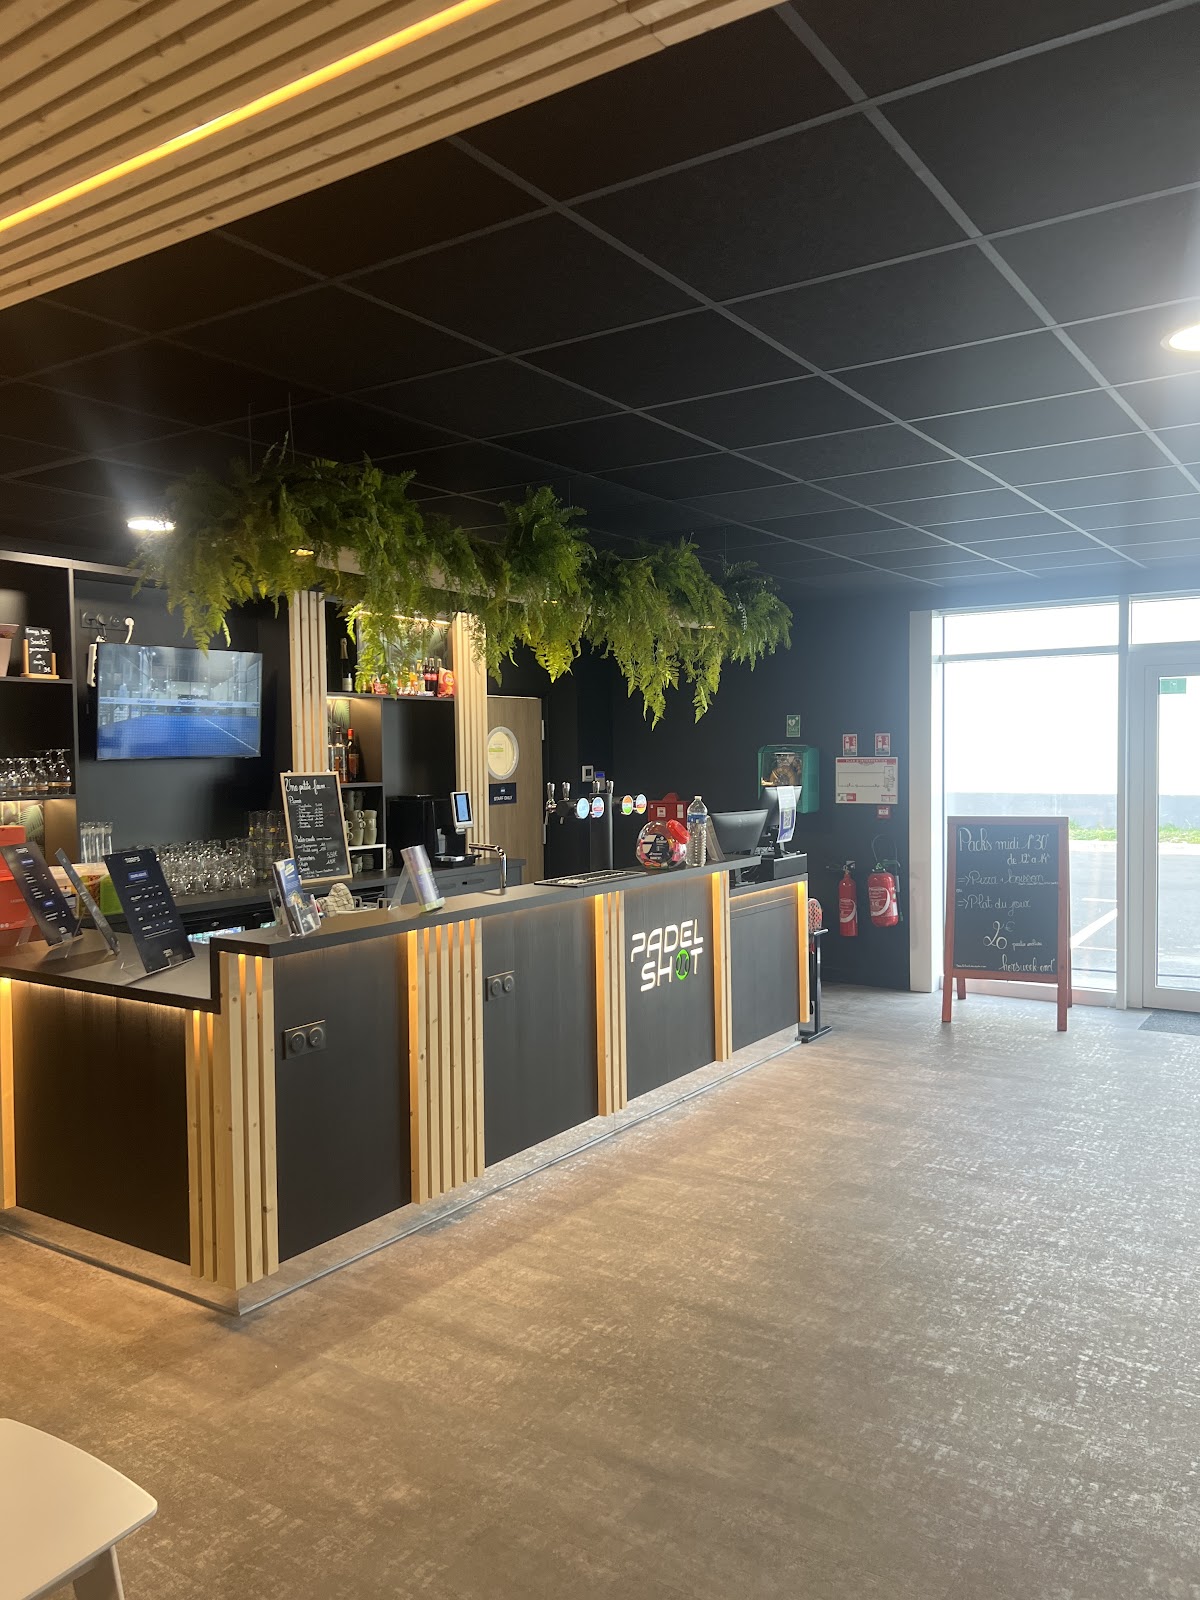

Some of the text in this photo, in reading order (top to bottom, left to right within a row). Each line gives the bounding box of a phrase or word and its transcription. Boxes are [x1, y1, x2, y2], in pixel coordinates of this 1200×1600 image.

[958, 826, 993, 852] Packs
[995, 836, 1021, 850] midi
[1006, 853, 1018, 865] de
[967, 893, 1031, 917] Plat du jour
[630, 918, 704, 963] PADEL
[640, 946, 704, 993] SHOT
